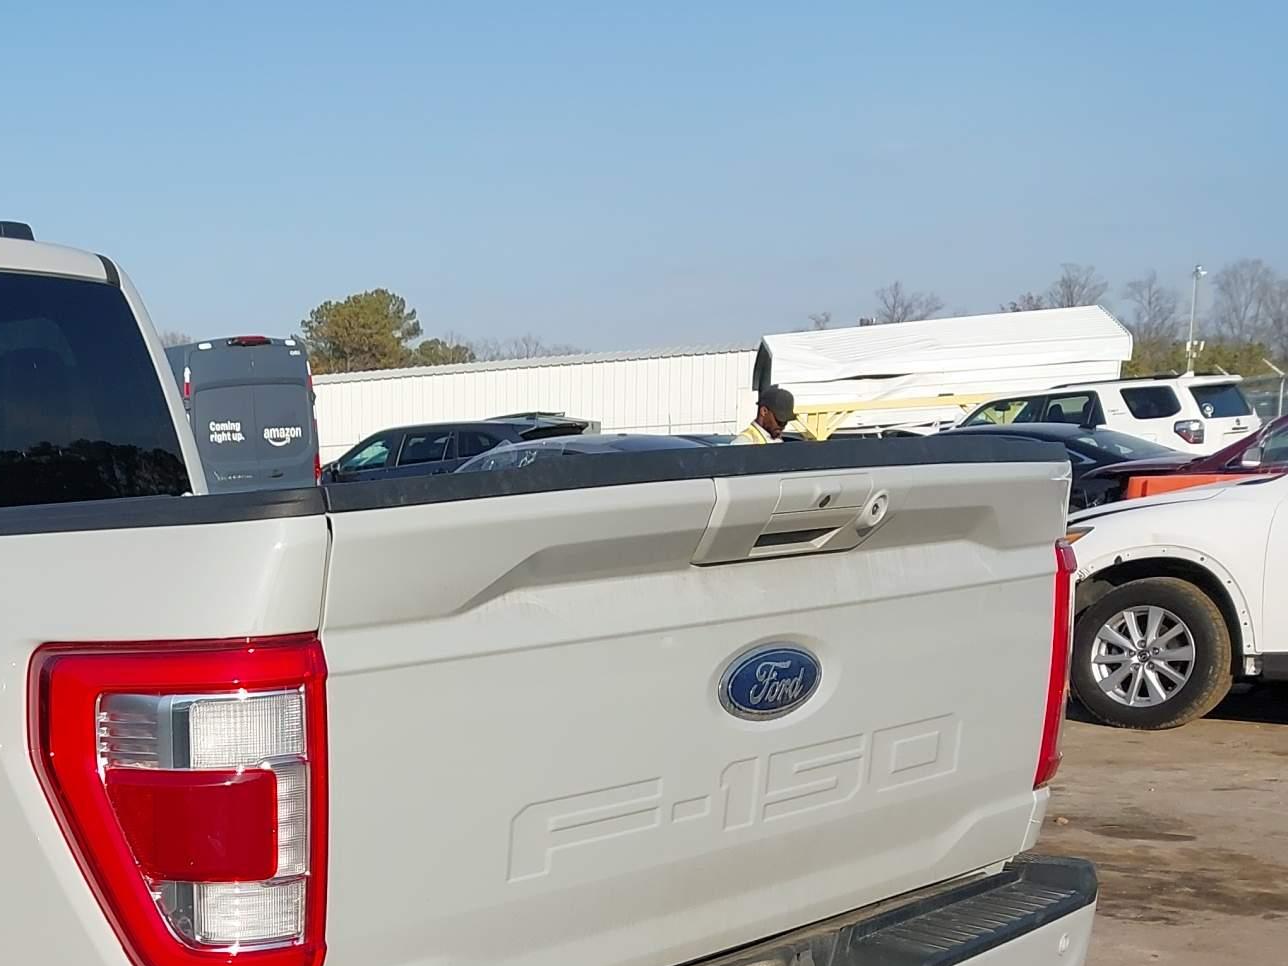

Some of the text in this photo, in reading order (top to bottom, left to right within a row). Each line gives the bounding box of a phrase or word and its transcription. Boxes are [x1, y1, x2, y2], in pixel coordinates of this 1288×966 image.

[209, 421, 240, 432] Coming
[210, 432, 245, 443] right up.
[263, 427, 302, 440] amazon
[749, 660, 805, 705] Ford
[505, 712, 963, 884] F-150
